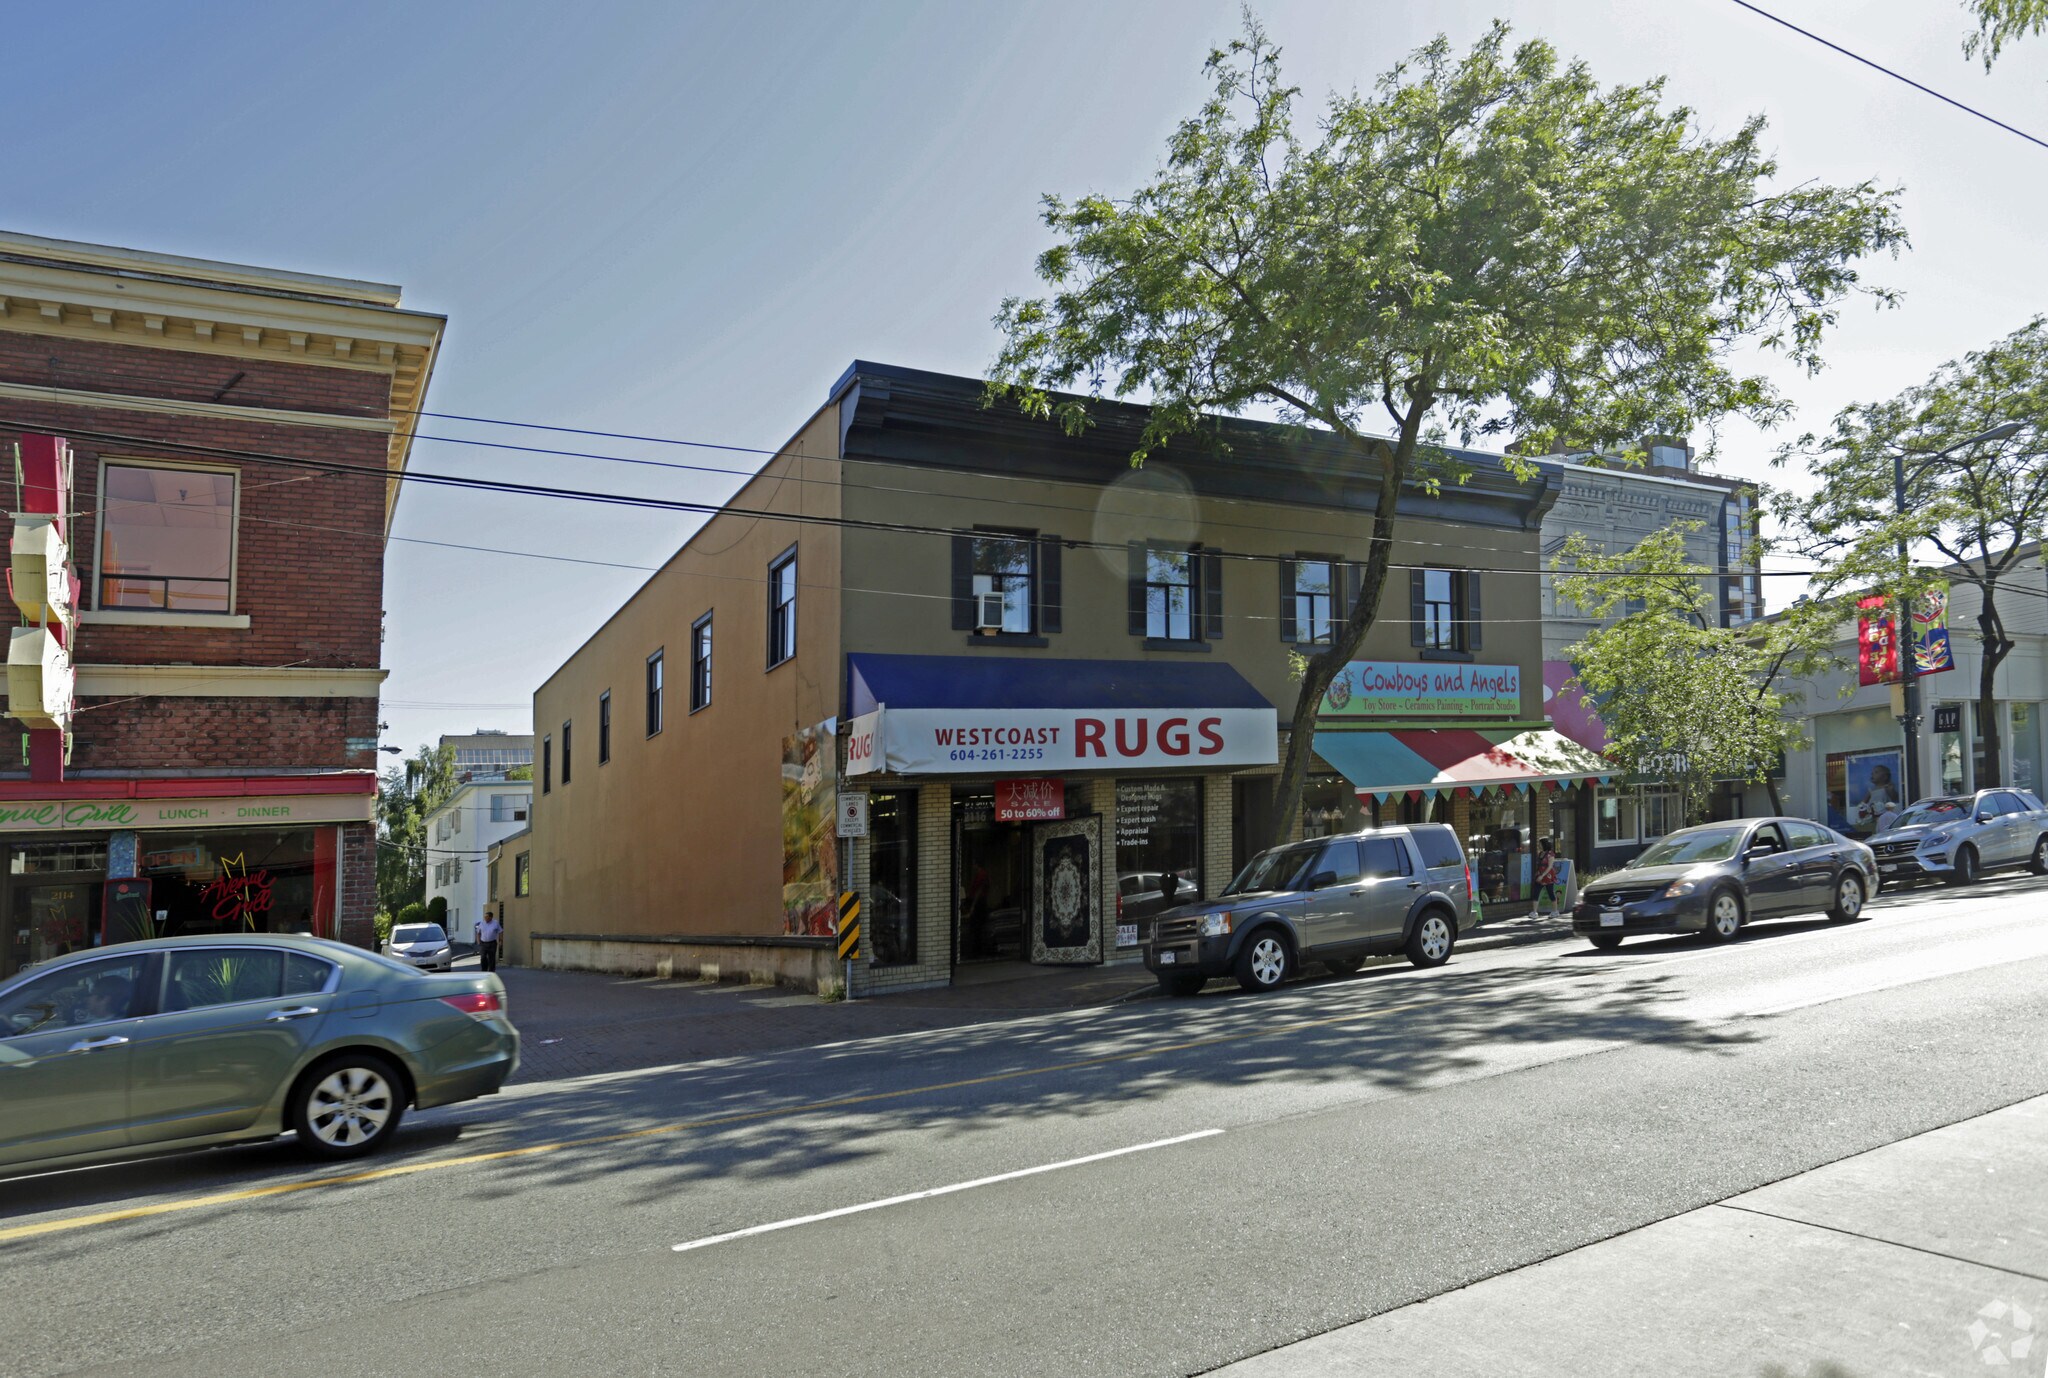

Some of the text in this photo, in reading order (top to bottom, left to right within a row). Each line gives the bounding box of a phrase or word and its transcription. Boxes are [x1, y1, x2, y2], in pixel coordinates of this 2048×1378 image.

[1362, 664, 1517, 701] Cowboys and Angels
[1362, 698, 1516, 713] Toy Store Ceramics Painting Portrait Studio
[1938, 712, 1956, 725] GAP
[934, 717, 1225, 758] WESTCOAST RUGS
[950, 748, 1043, 761] 604-261-2255
[1006, 781, 1055, 801] 大减价
[64, 803, 138, 826] Grill
[159, 808, 209, 820] LUNCH
[237, 806, 290, 818] DINNER
[1000, 807, 1060, 819] 50 to 60% off
[1120, 803, 1159, 814] Expert repair
[1120, 815, 1157, 825] Expert wash
[1120, 826, 1149, 836] Appraisal
[1120, 838, 1149, 846] Trade-ins
[141, 851, 197, 867] OPEN
[199, 869, 277, 903] Avenue
[212, 889, 276, 920] Grill
[1115, 925, 1137, 935] SALE
